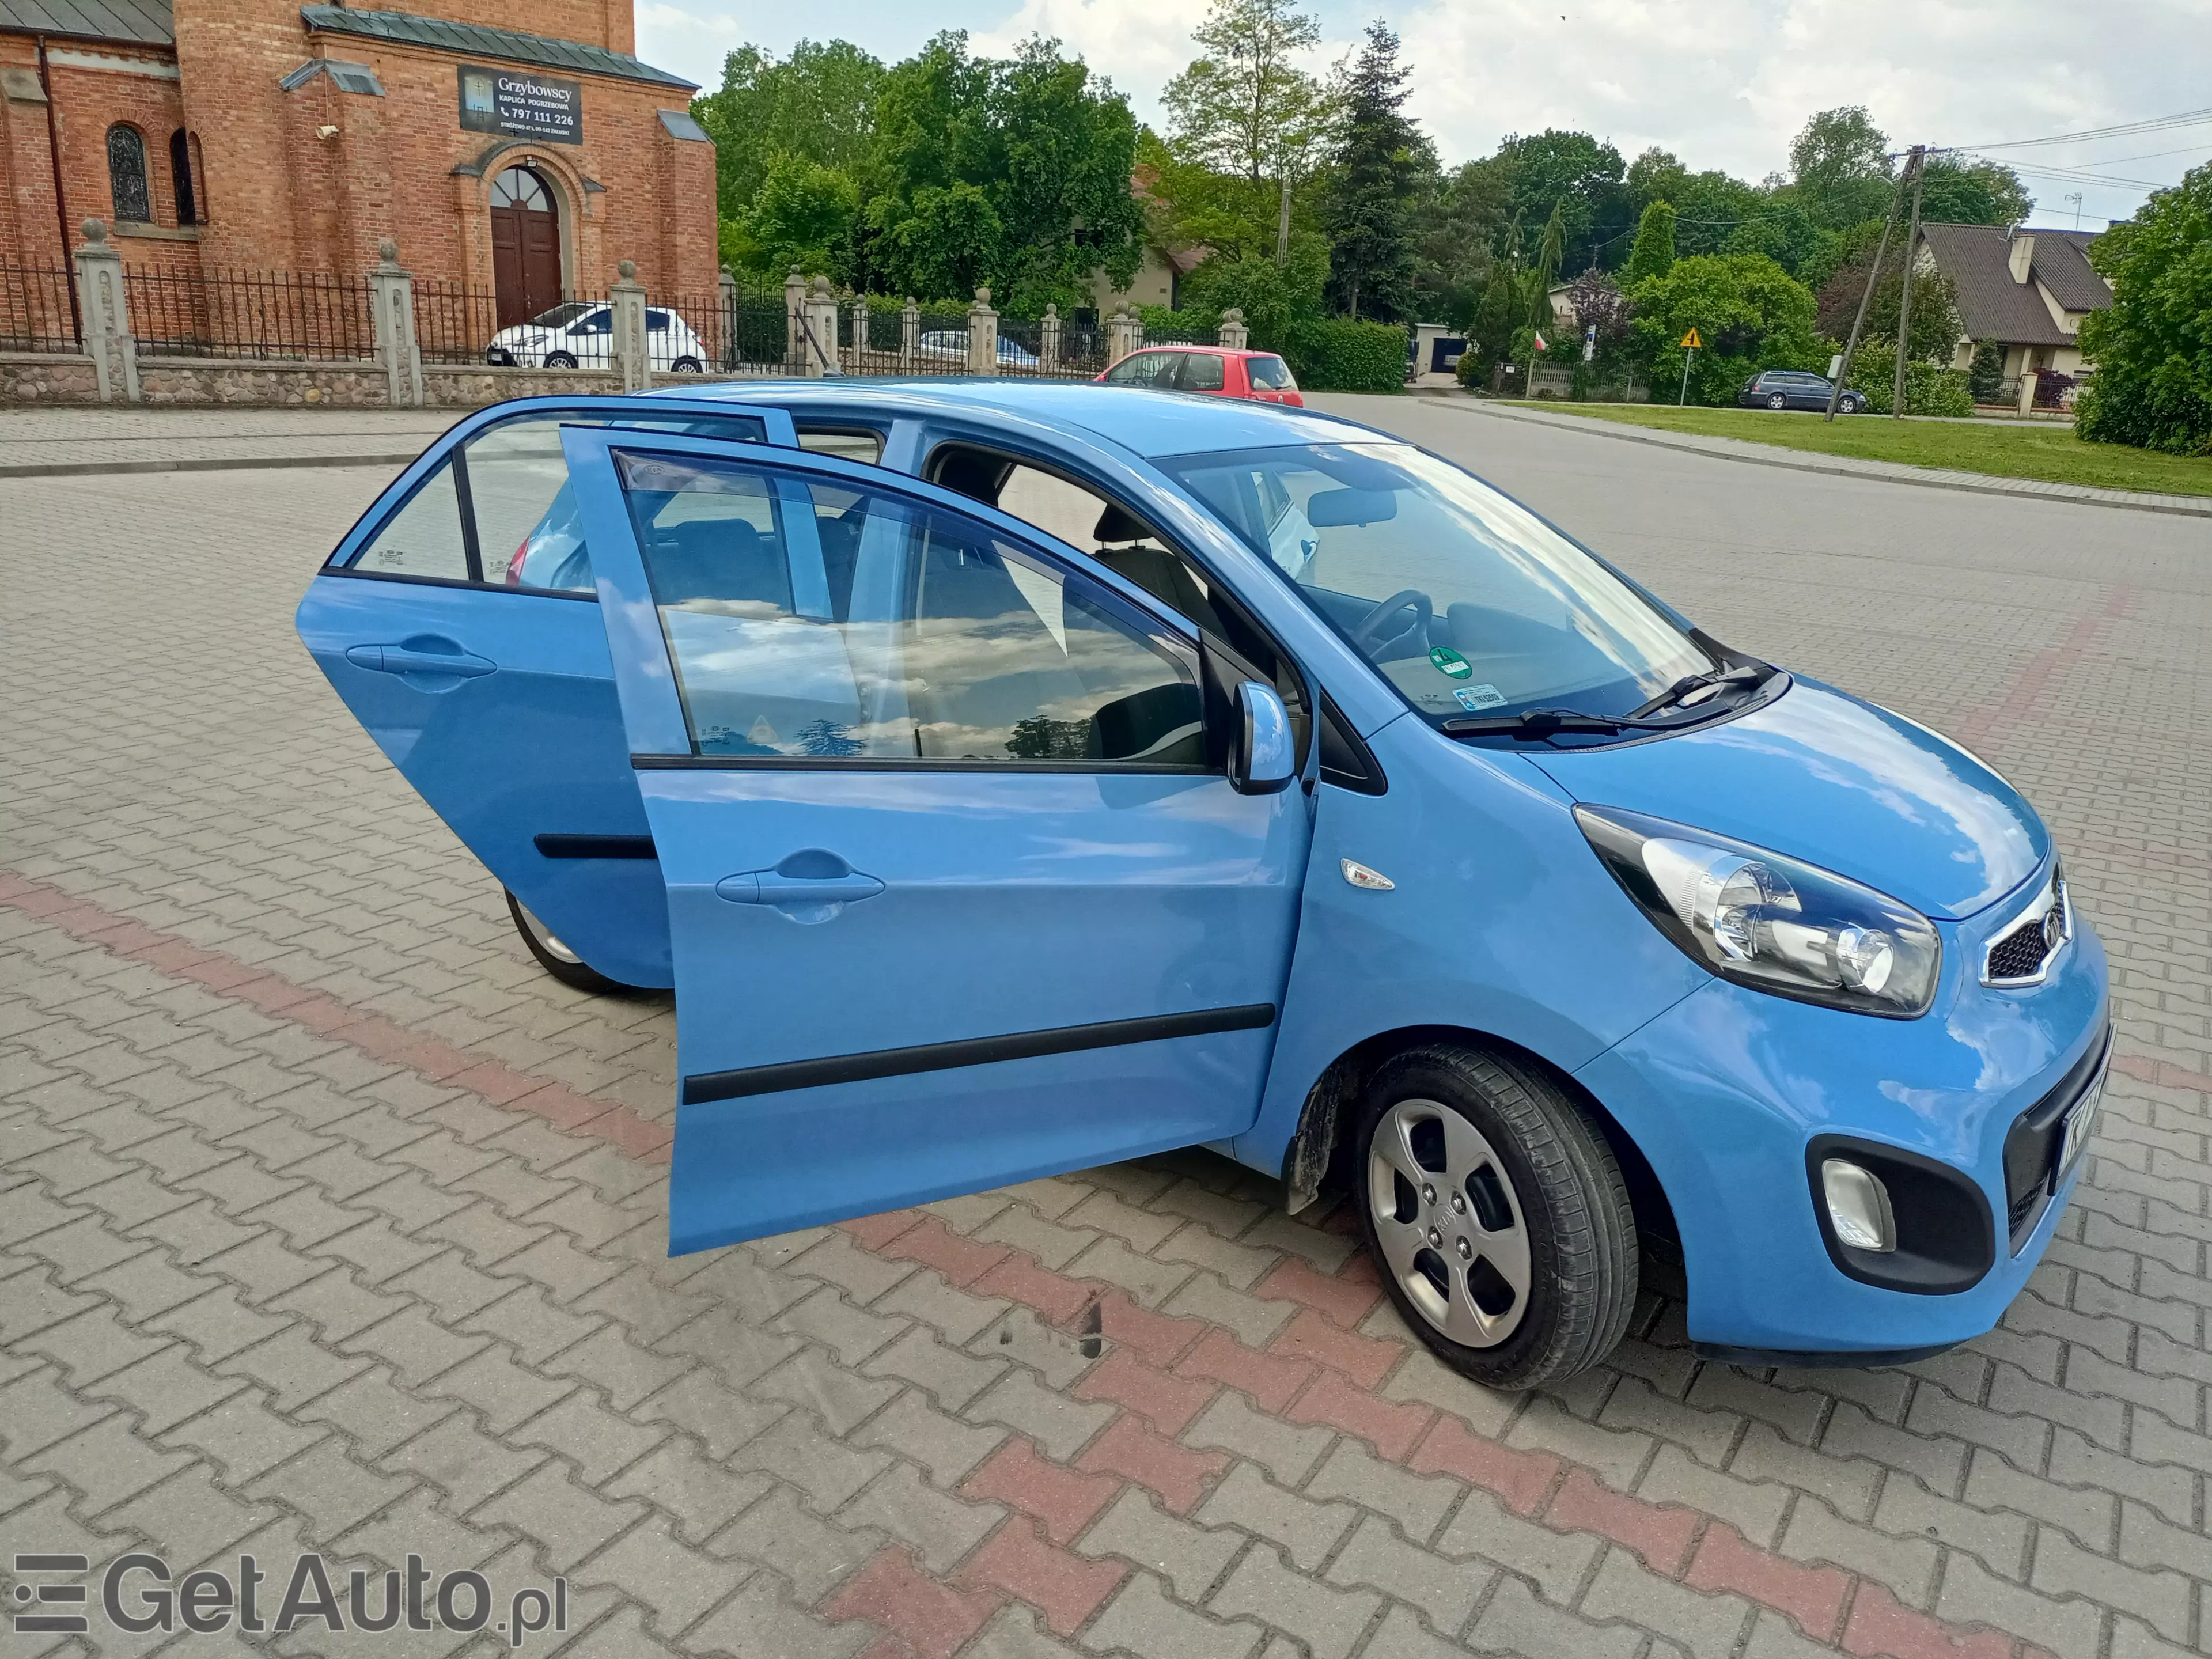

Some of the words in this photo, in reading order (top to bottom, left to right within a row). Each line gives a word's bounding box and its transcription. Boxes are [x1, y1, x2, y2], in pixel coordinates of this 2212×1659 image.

[498, 78, 572, 102] Grzybowscy
[499, 94, 525, 104] KAPLICA
[528, 99, 569, 111] POGRZEBOWA
[512, 108, 531, 119] 797
[534, 112, 551, 123] 111
[555, 115, 574, 126] 226
[1437, 648, 1452, 662] 4
[1437, 1211, 1453, 1232] KIA
